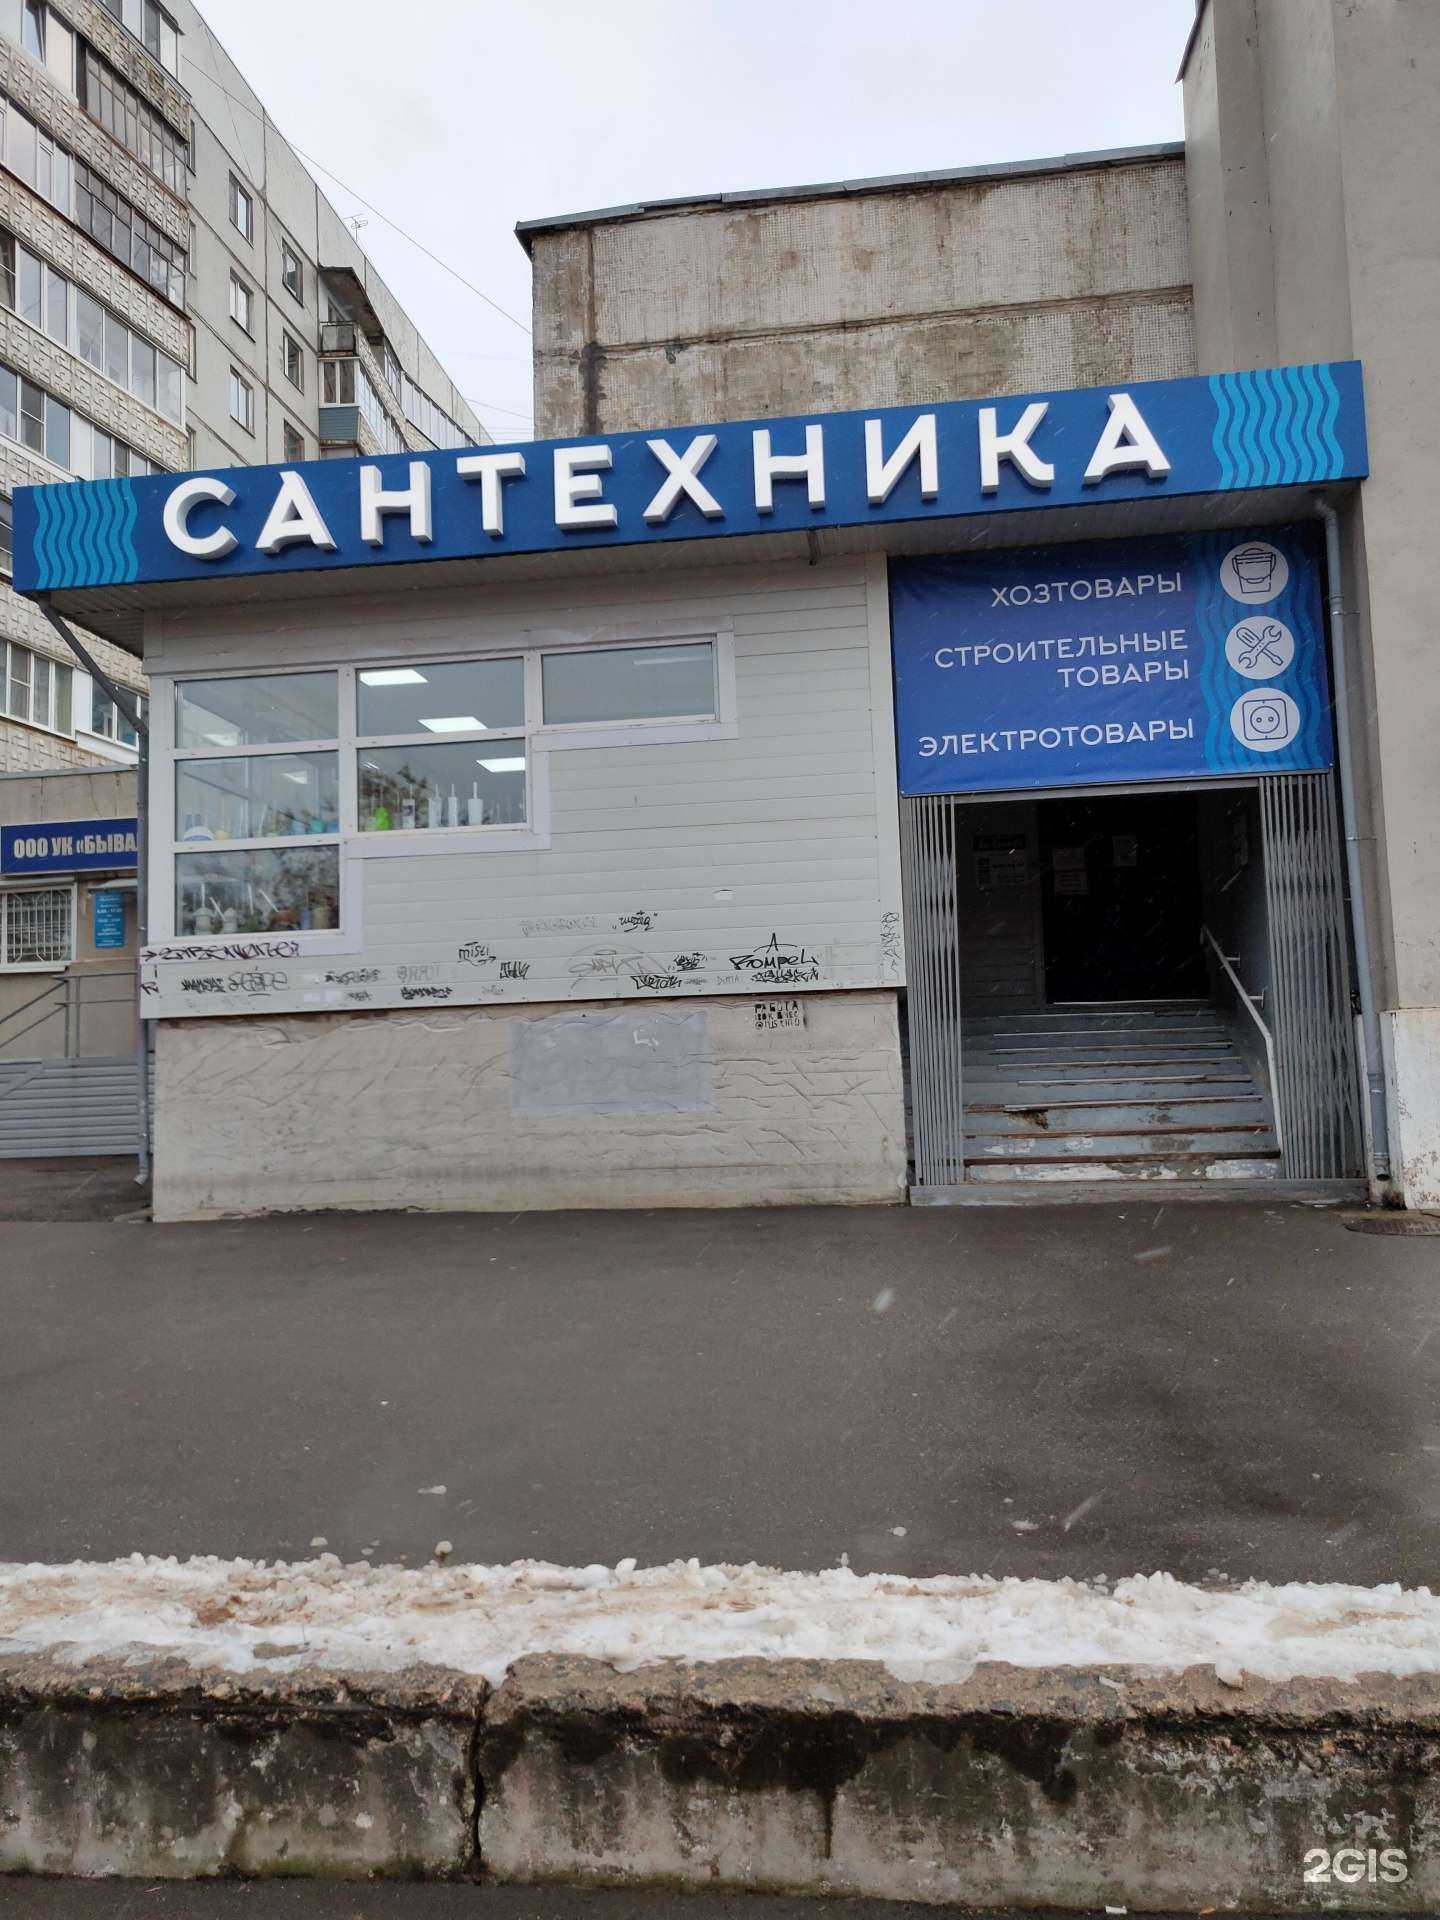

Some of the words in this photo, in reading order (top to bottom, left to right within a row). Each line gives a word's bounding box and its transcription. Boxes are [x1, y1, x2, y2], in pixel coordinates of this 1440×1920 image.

[162, 392, 1172, 561] САНТЕХНИКА
[990, 571, 1182, 608] ХОЗТОВАРЫ
[934, 629, 1189, 669] СТРОИТЕЛЬНЫЕ
[1057, 659, 1190, 688] ТОВАРЫ
[918, 718, 1194, 757] ЭЛЕКТРОТОВАРЫ
[14, 838, 48, 858] ООО
[52, 836, 73, 856] УК
[77, 832, 138, 853] «БЫВА
